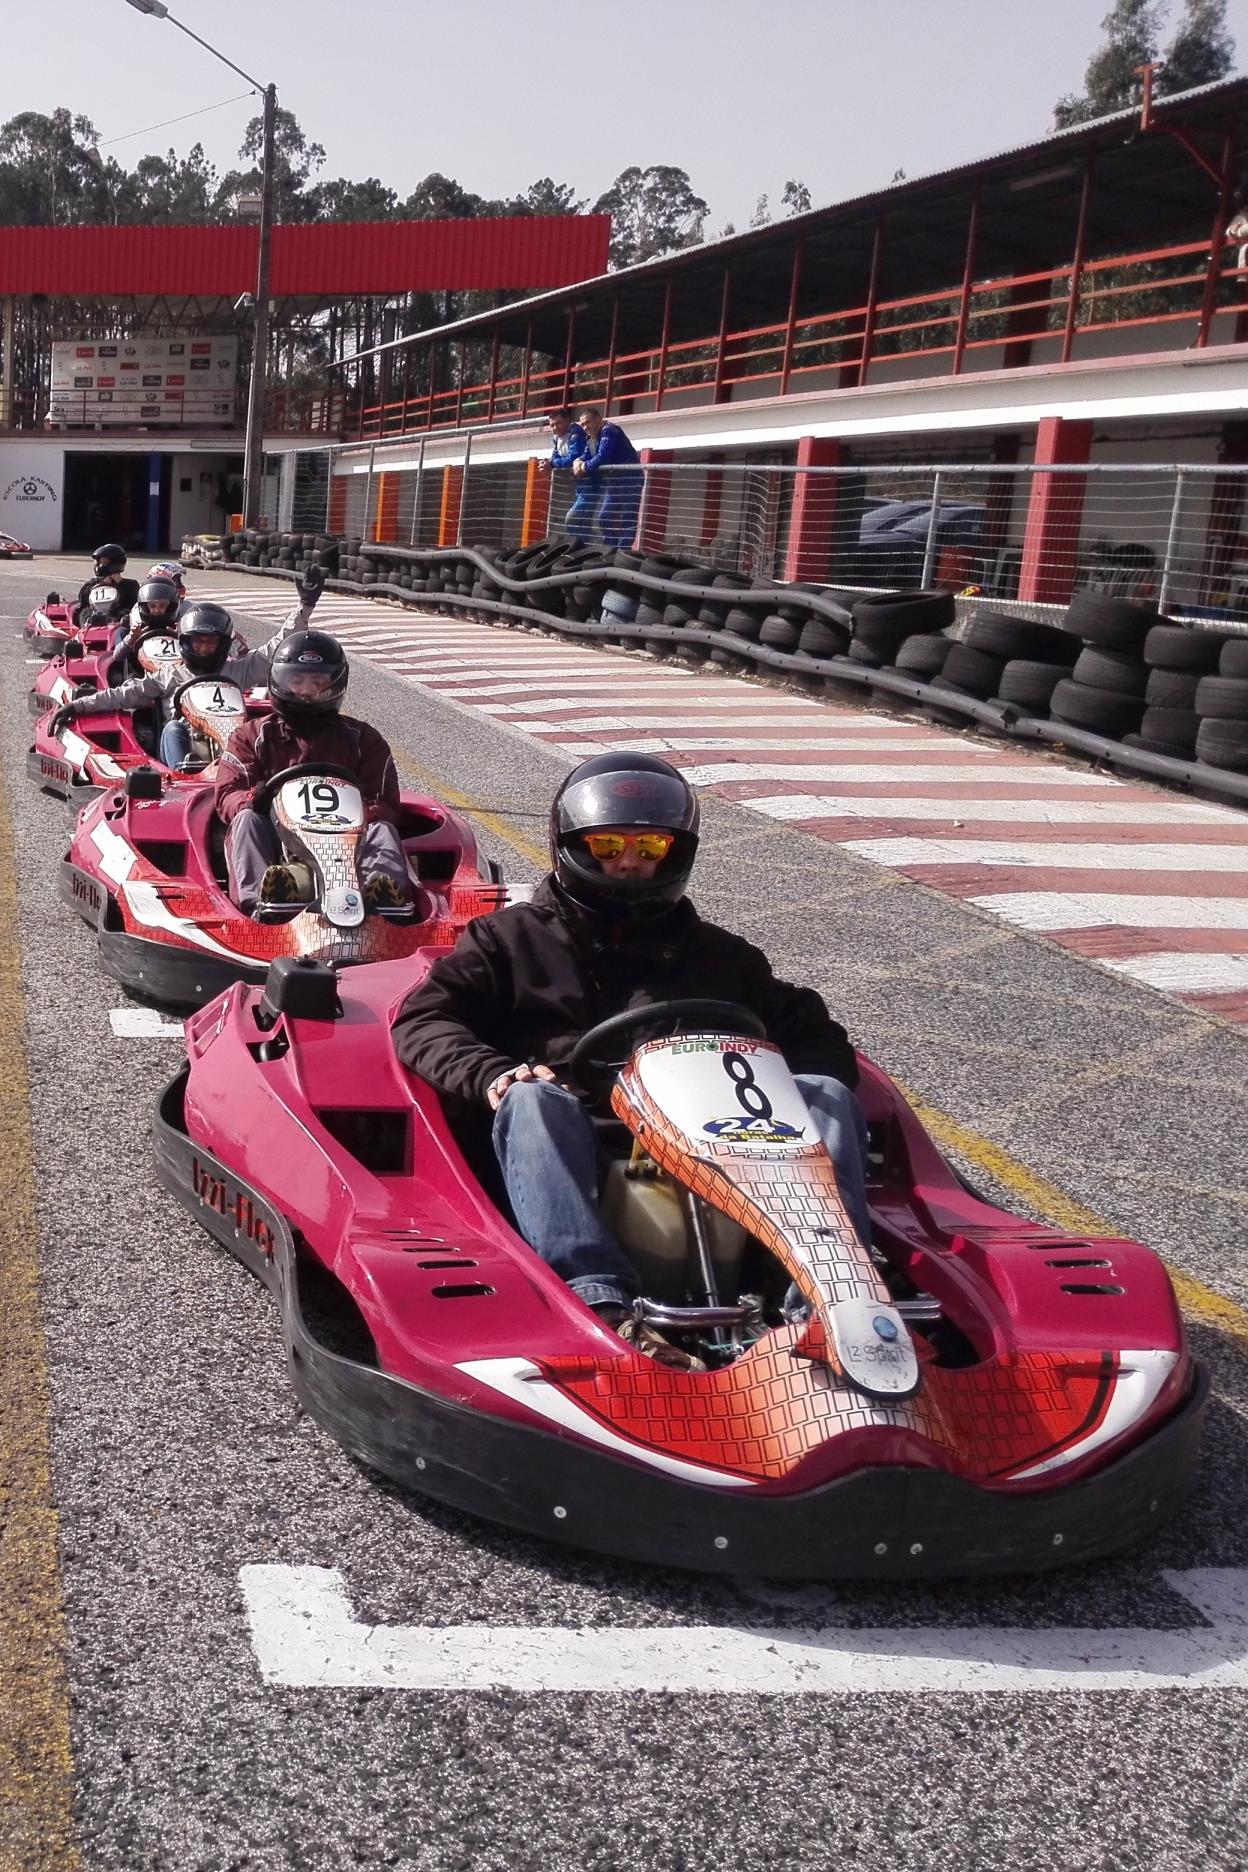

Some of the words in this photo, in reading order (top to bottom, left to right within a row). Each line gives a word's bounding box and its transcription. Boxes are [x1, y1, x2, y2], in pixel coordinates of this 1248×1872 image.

[3, 476, 26, 500] ESCOLA
[30, 476, 57, 501] KARTING
[95, 588, 105, 600] 11
[161, 639, 176, 654] 21
[213, 687, 225, 708] 4
[298, 783, 340, 814] 19
[671, 1041, 758, 1055] EUROINDY
[722, 1052, 773, 1120] 8
[715, 1118, 775, 1133] 24
